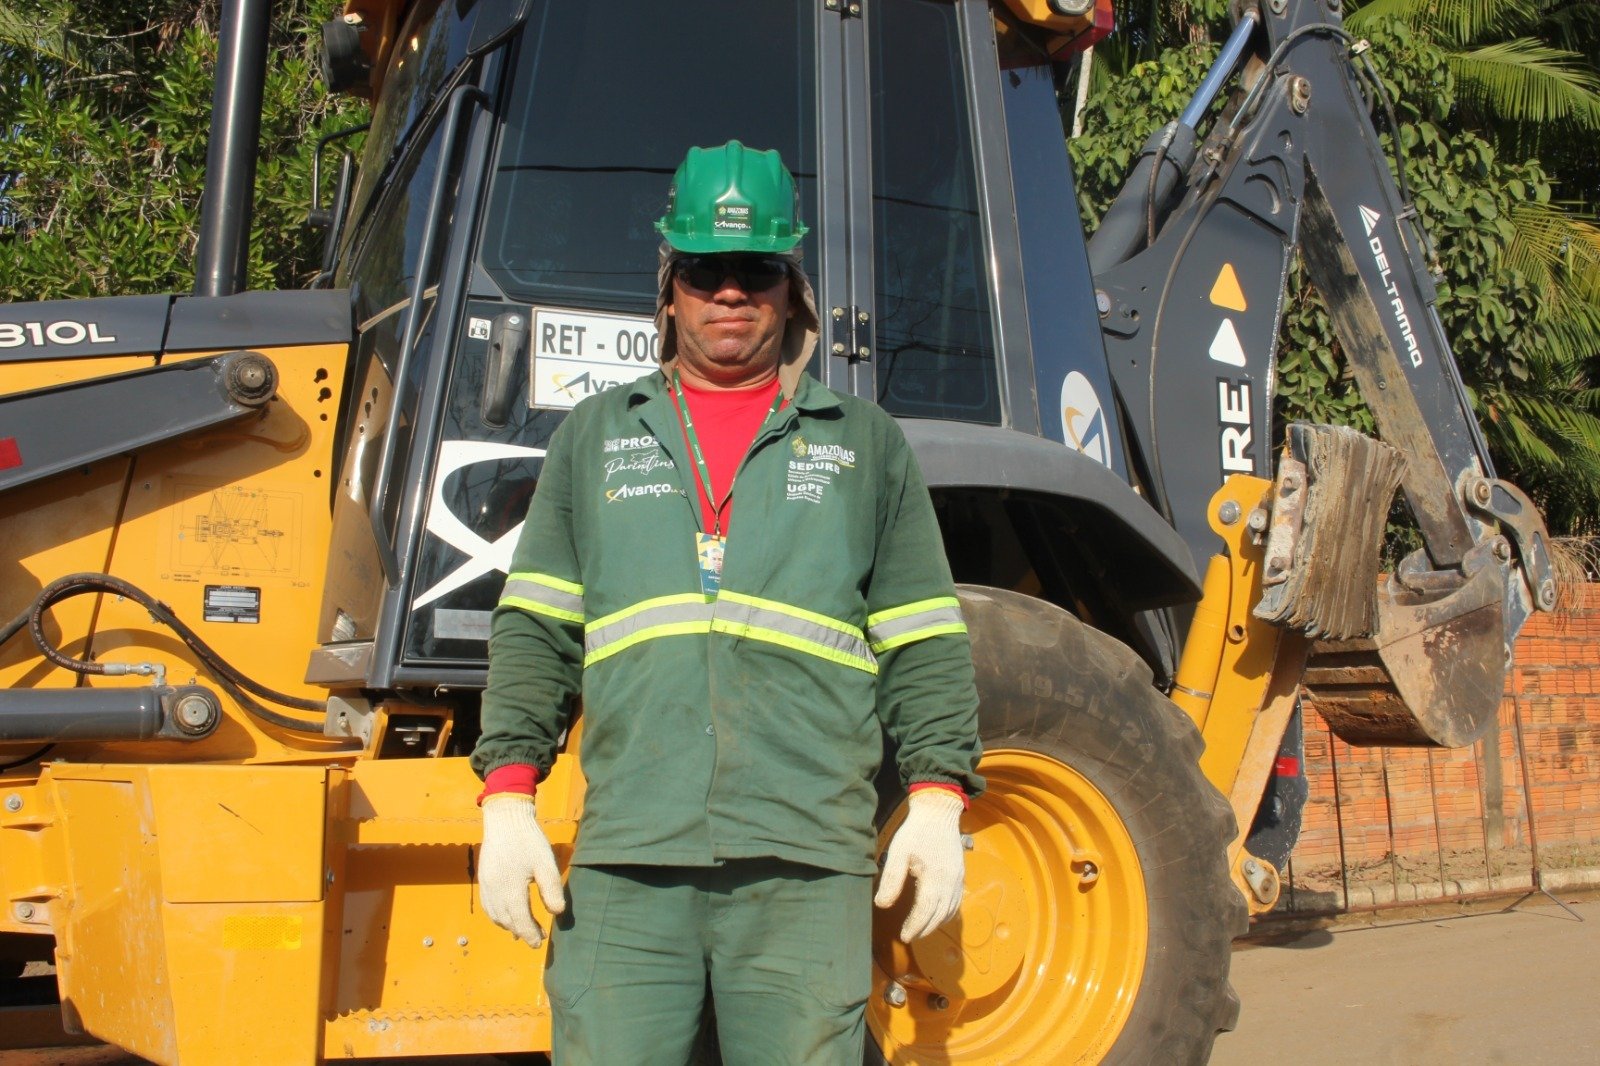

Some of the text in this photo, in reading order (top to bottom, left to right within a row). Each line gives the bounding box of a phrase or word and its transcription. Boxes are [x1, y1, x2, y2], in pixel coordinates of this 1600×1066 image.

[542, 322, 587, 356] RET
[1219, 381, 1253, 484] RE
[807, 443, 855, 463] AMAZONAS
[604, 455, 675, 482] Parintins
[606, 483, 671, 504] Avanço
[787, 483, 824, 496] UGPE
